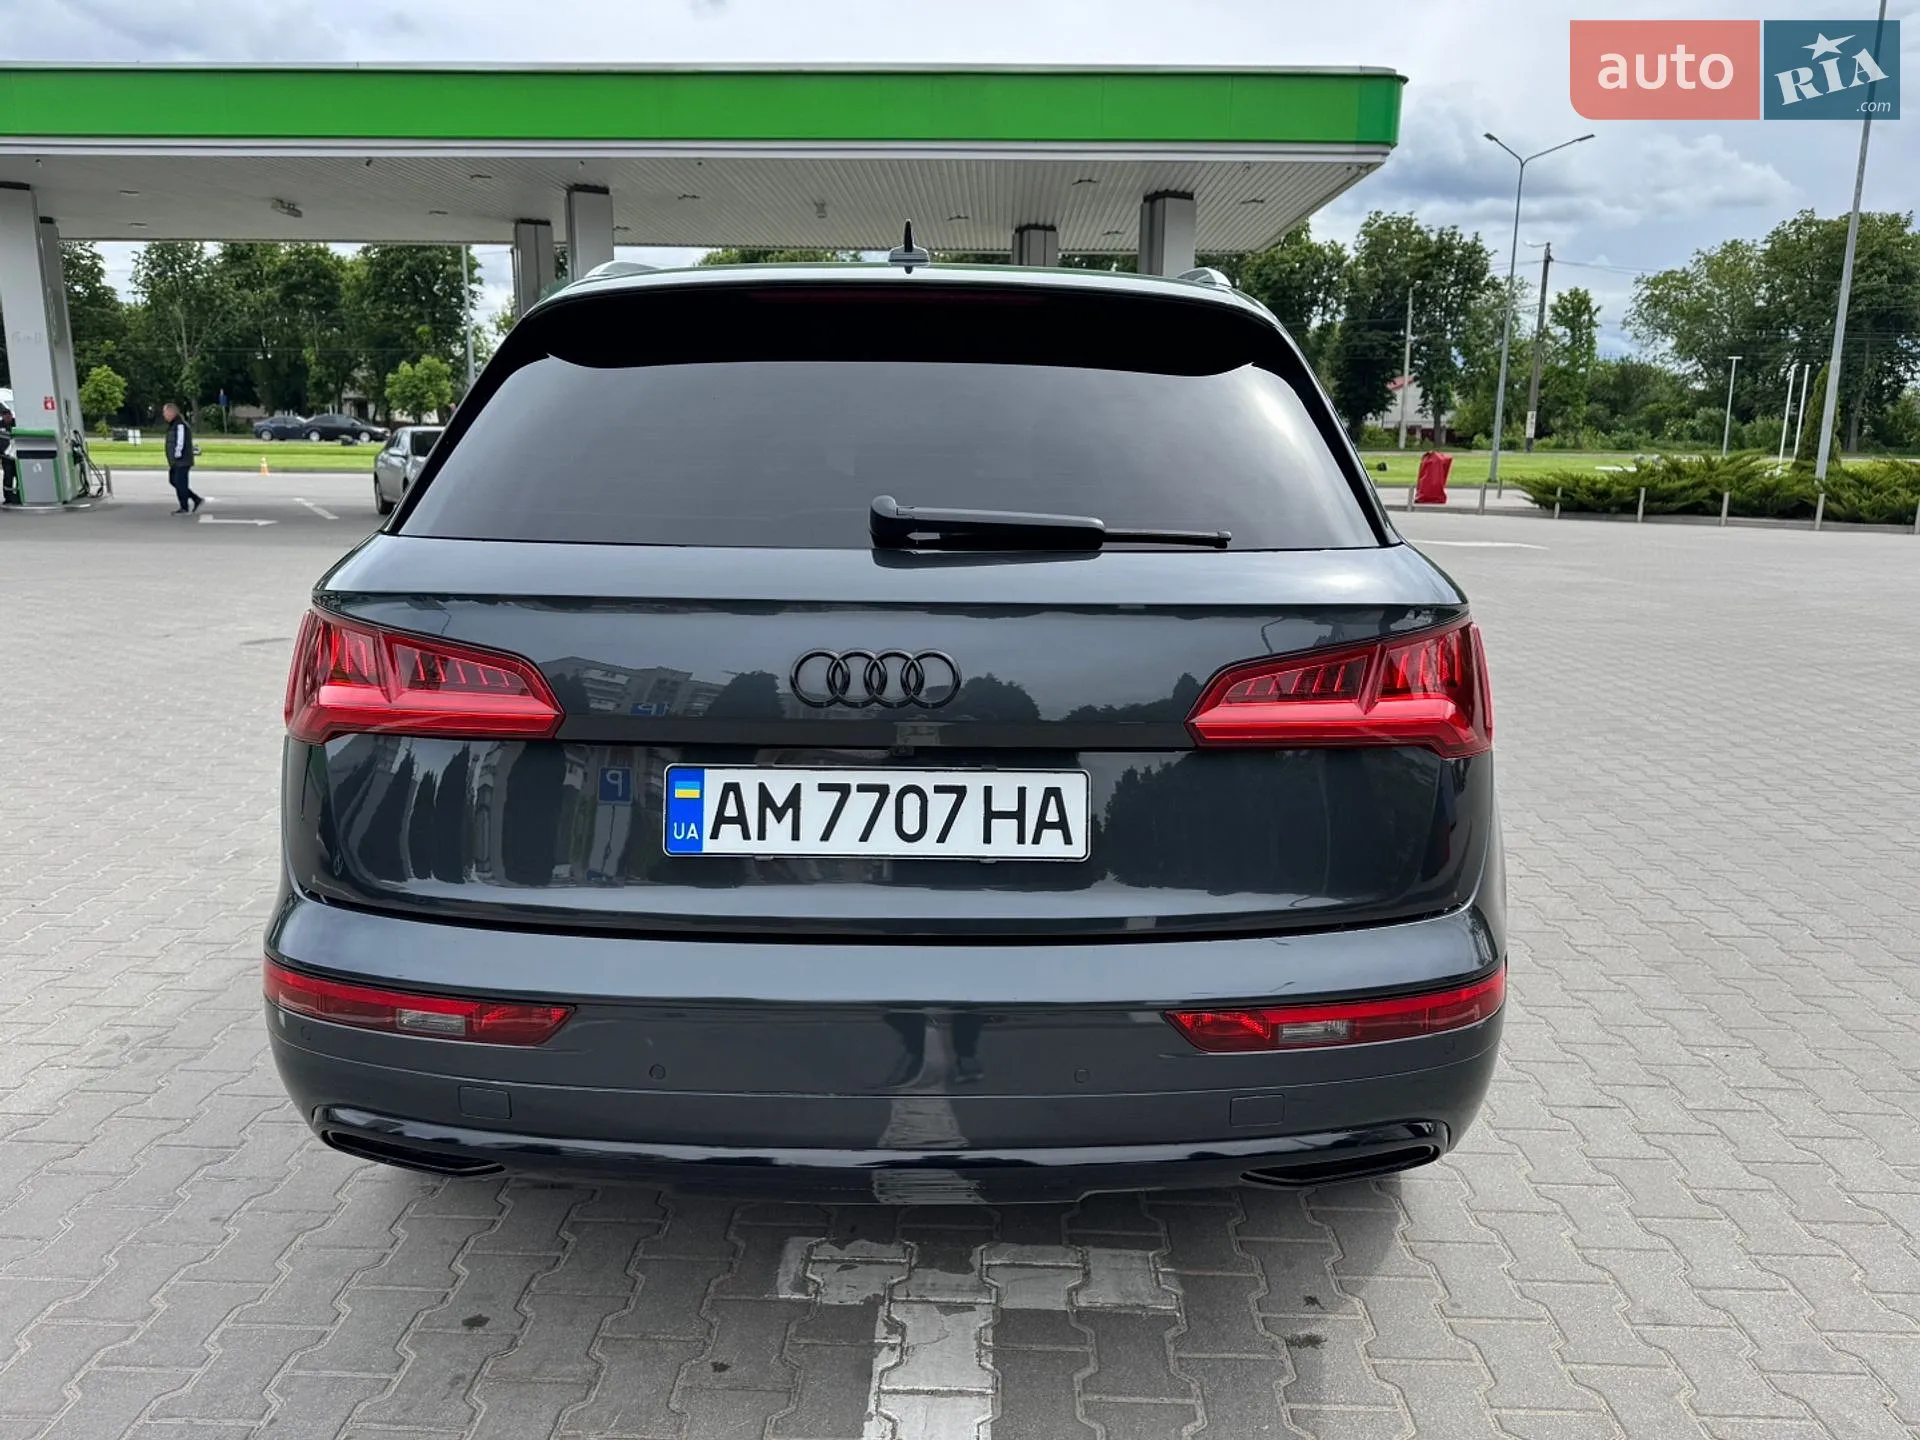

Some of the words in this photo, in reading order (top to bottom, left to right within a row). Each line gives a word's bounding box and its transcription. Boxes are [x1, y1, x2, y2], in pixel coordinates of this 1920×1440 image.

[673, 821, 699, 840] UA
[709, 781, 801, 841] AM
[817, 783, 967, 843] 7707
[982, 785, 1074, 845] HA
